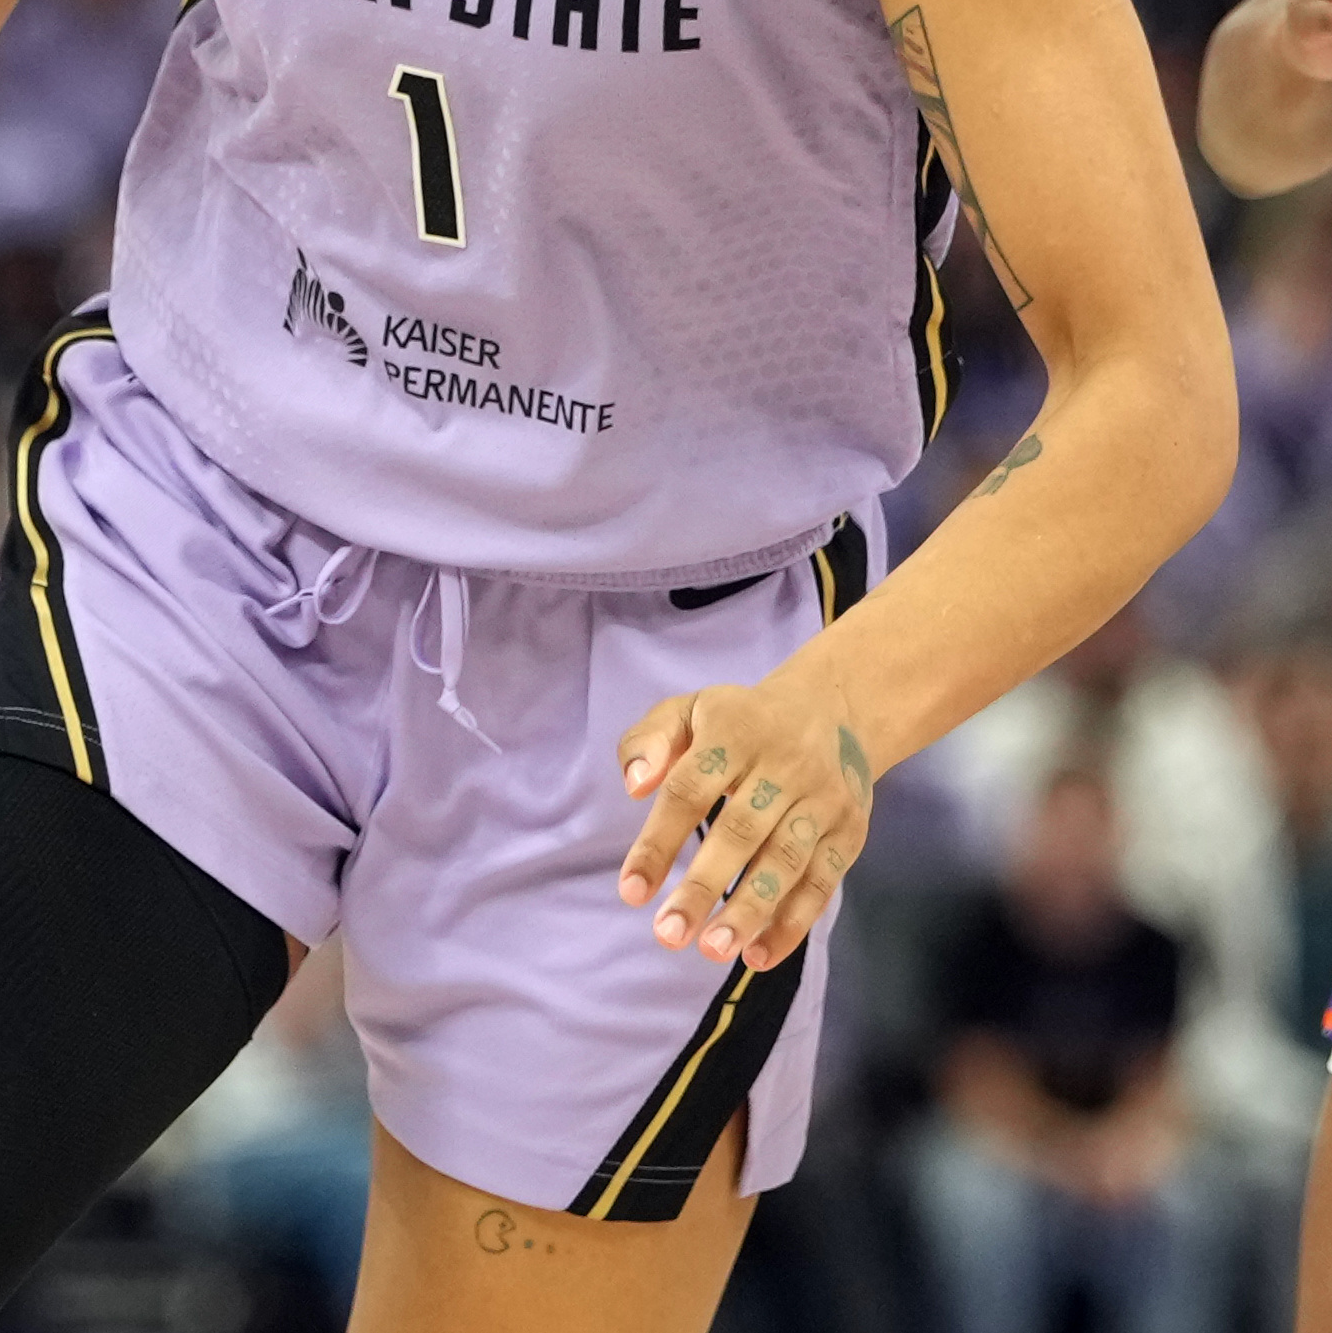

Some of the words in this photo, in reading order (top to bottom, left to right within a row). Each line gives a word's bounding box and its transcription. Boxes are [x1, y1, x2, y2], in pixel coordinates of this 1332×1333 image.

[386, 63, 467, 249] 1
[382, 314, 501, 370] KAISER
[382, 359, 617, 435] PERMANENTE
